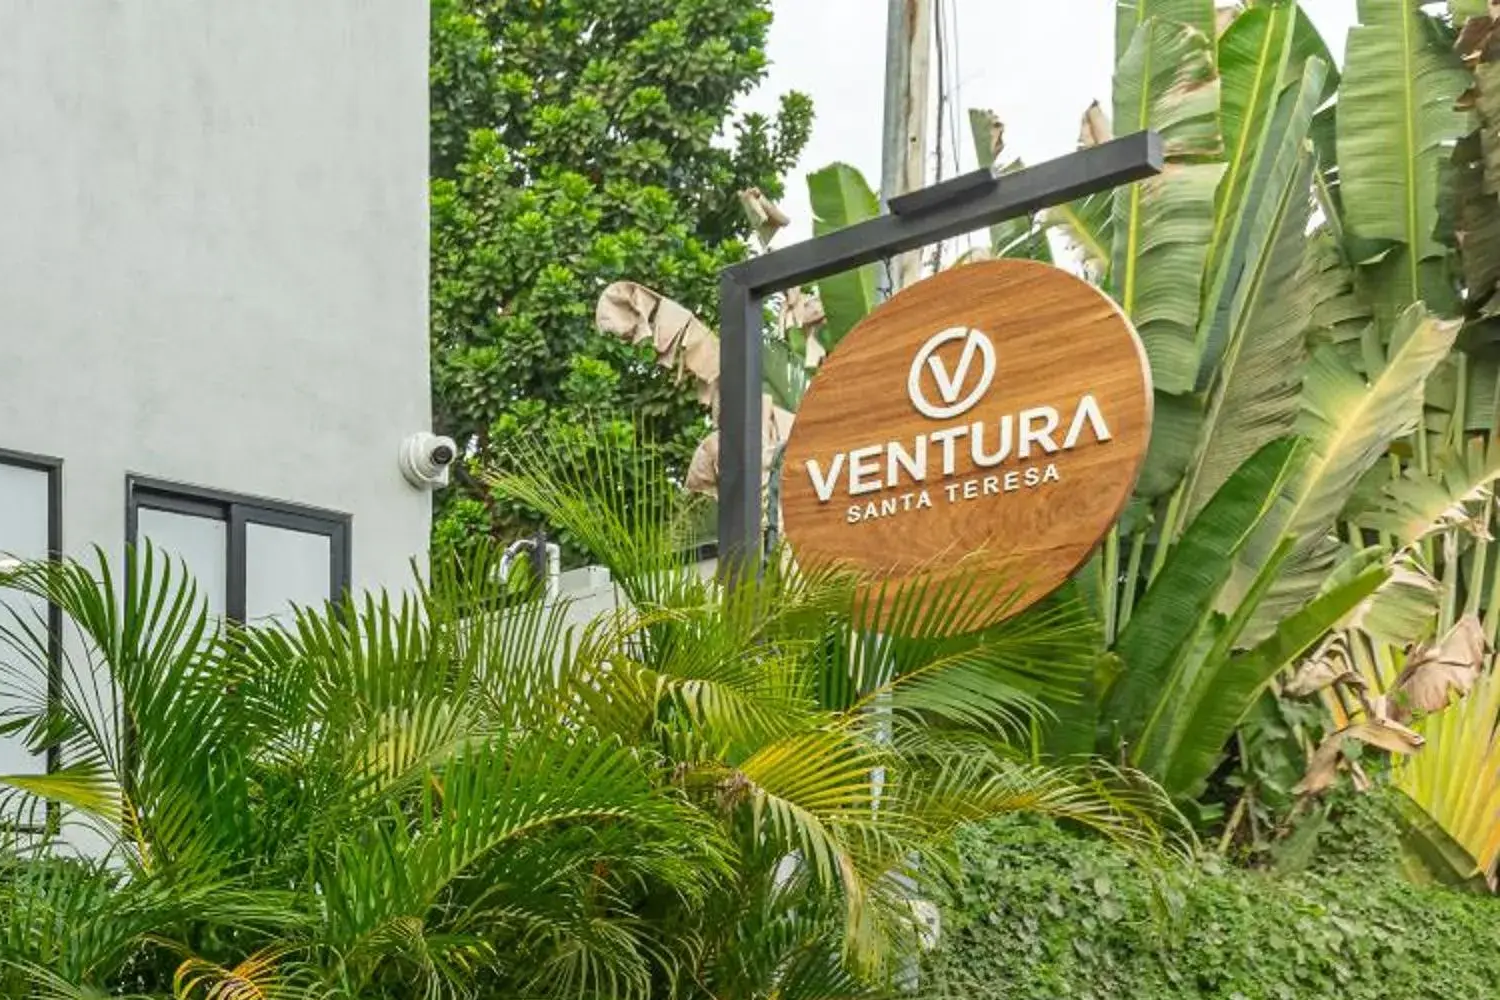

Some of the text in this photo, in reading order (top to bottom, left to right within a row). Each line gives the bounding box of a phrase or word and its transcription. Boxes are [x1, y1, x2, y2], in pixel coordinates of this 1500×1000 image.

[805, 395, 1111, 502] VENTURA
[846, 463, 1060, 524] SANTA TERESA
